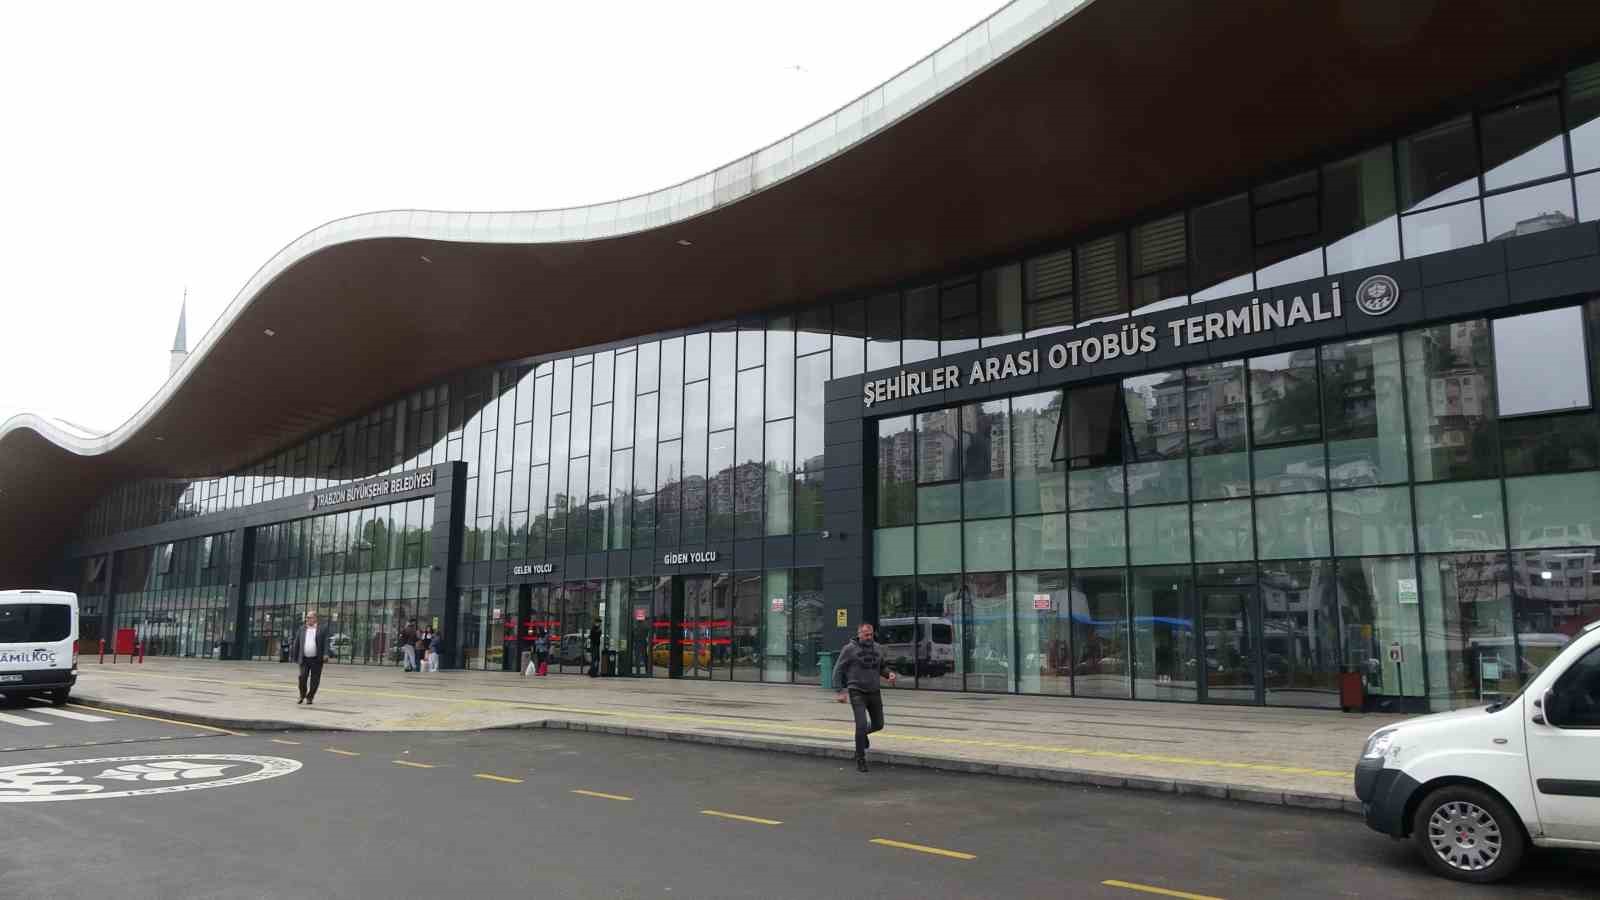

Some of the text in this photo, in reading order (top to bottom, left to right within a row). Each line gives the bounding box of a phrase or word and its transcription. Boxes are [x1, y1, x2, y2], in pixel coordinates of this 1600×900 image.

[863, 281, 1342, 407] ŞEHİRLER ARASI OTOBÜS TERMİNALİ
[317, 490, 345, 506] TRABZON
[391, 469, 433, 492] BELEDİYESİ
[513, 563, 553, 576] GELEN YOLCU
[664, 551, 717, 565] GİDEN YOLCU
